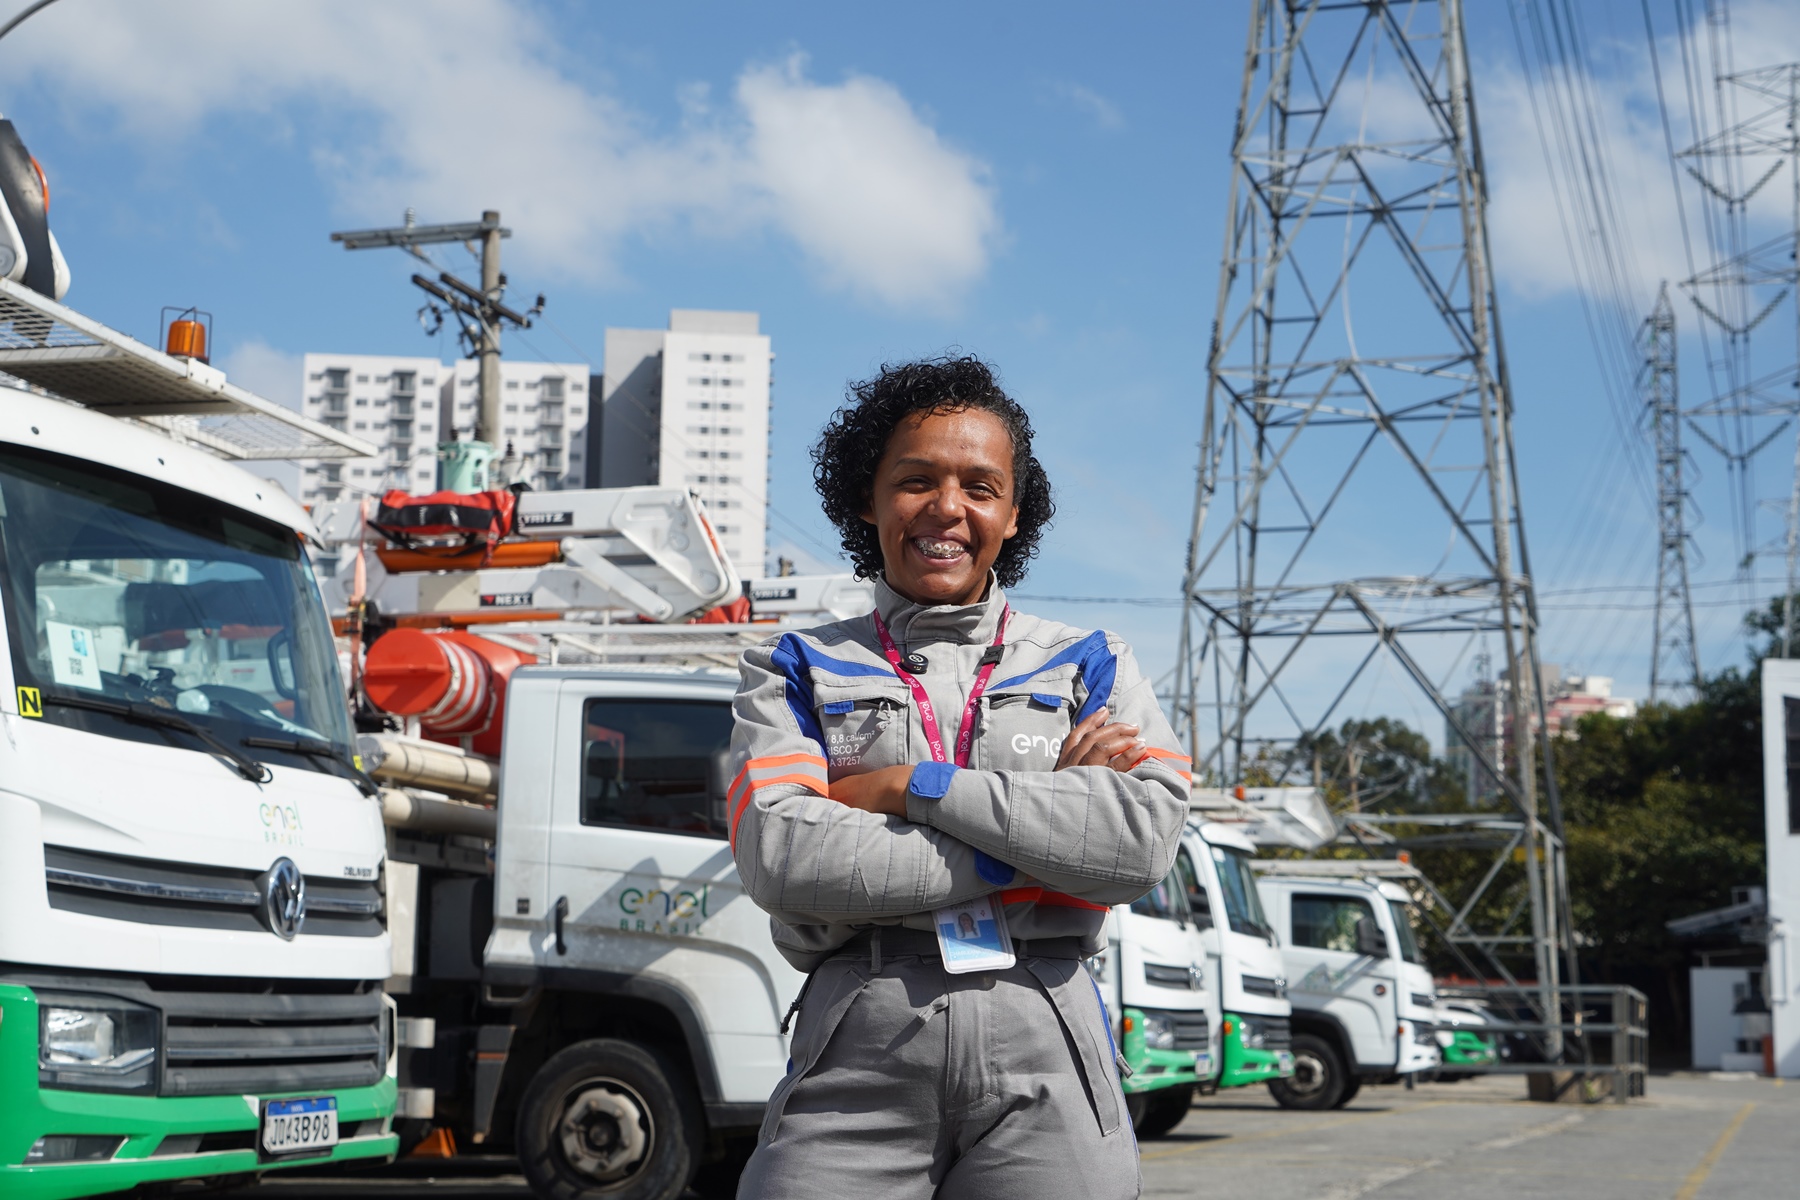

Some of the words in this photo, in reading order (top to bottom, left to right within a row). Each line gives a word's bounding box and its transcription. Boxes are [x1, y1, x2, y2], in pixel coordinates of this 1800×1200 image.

[20, 689, 39, 712] N
[920, 700, 934, 722] enel
[831, 733, 844, 744] 8,8
[854, 743, 860, 753] 2
[961, 730, 970, 752] enel
[837, 755, 862, 767] 37257
[931, 740, 945, 762] enel
[260, 801, 302, 830] enel
[619, 883, 708, 919] enel
[620, 918, 704, 936] BRASIL
